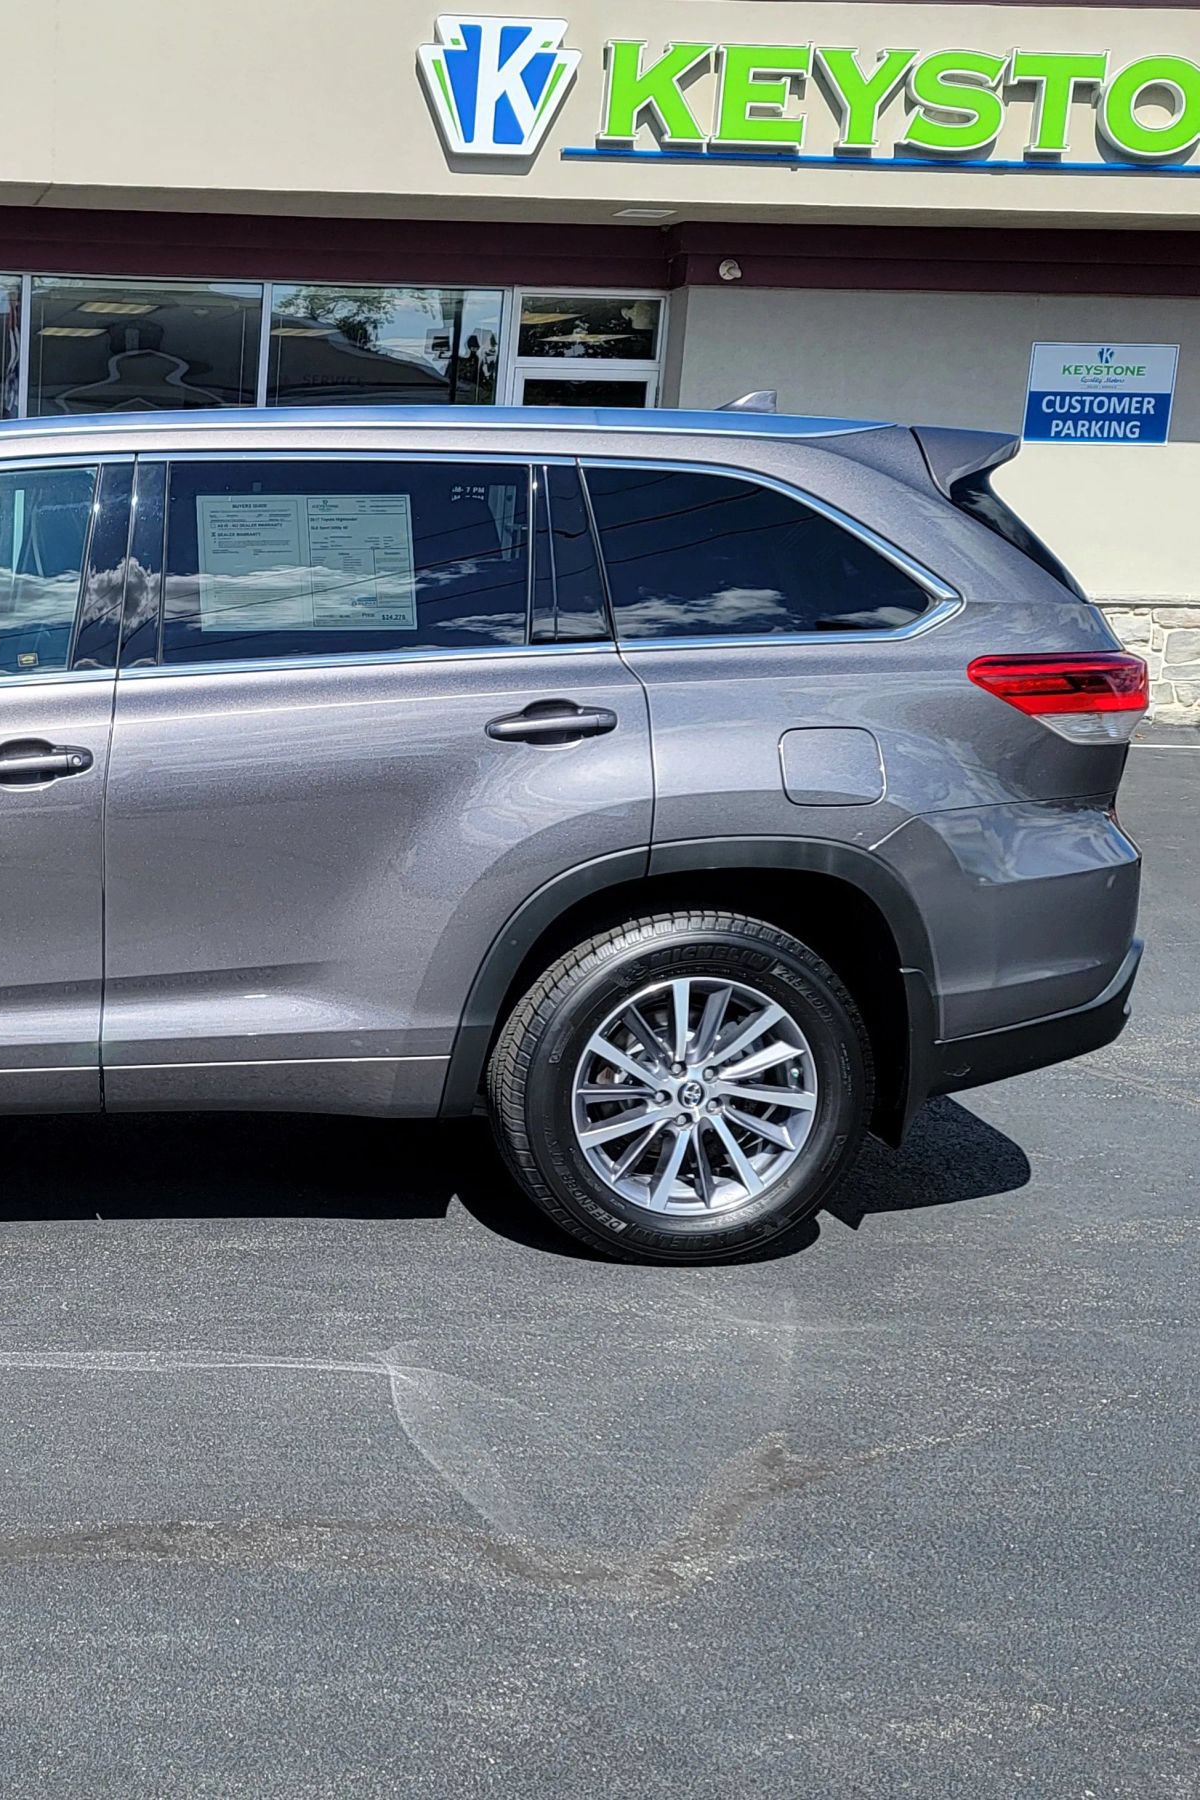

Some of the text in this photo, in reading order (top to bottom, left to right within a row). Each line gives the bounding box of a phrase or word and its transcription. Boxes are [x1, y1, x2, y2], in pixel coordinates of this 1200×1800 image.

[599, 38, 1200, 156] KEYSTO
[1062, 364, 1146, 376] KEYSTONE
[1041, 395, 1155, 415] CUSTOMER
[1050, 420, 1141, 438] PARKING
[650, 944, 769, 970] MICHELIN
